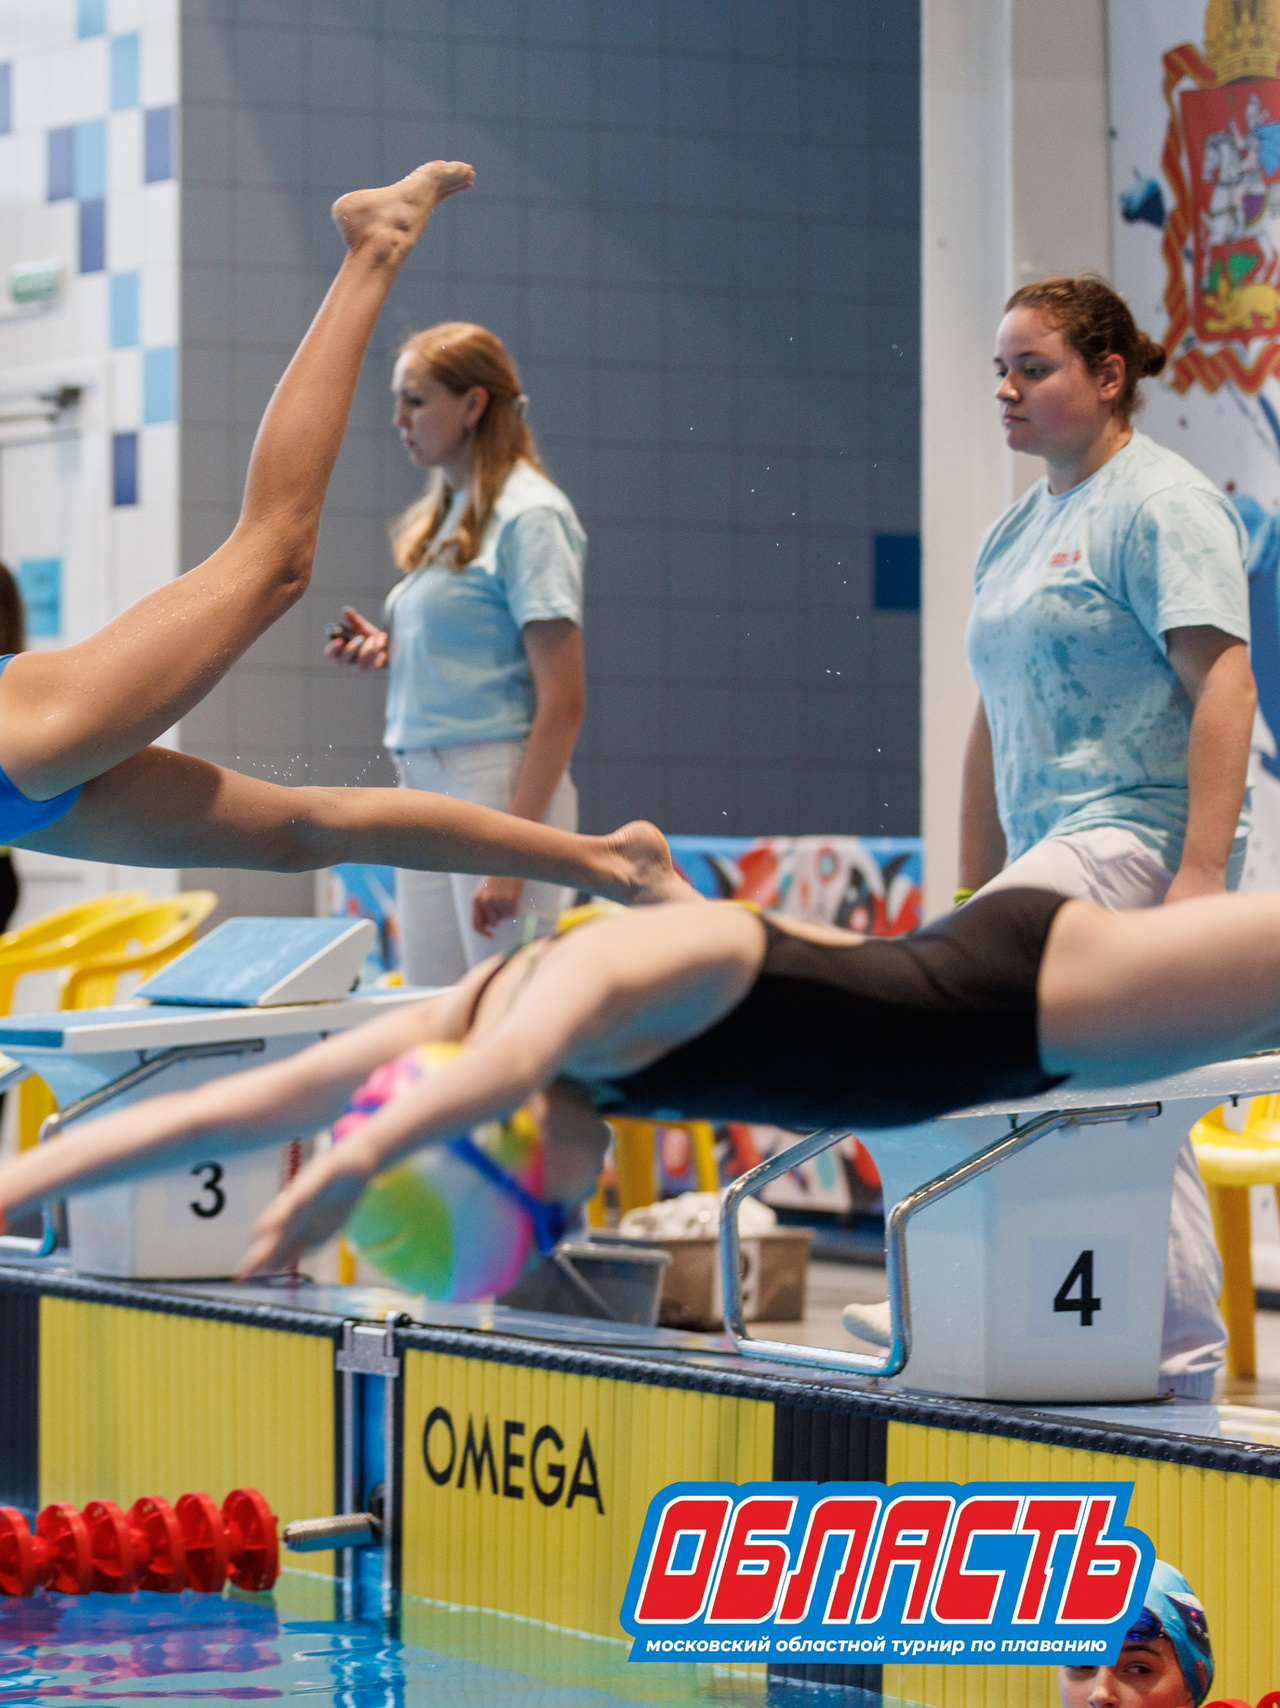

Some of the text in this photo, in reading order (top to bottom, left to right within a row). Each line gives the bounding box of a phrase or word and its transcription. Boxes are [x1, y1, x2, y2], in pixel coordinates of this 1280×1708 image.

[191, 1161, 225, 1218] 3
[1053, 1249, 1101, 1327] 4
[422, 1405, 606, 1516] OMEGA
